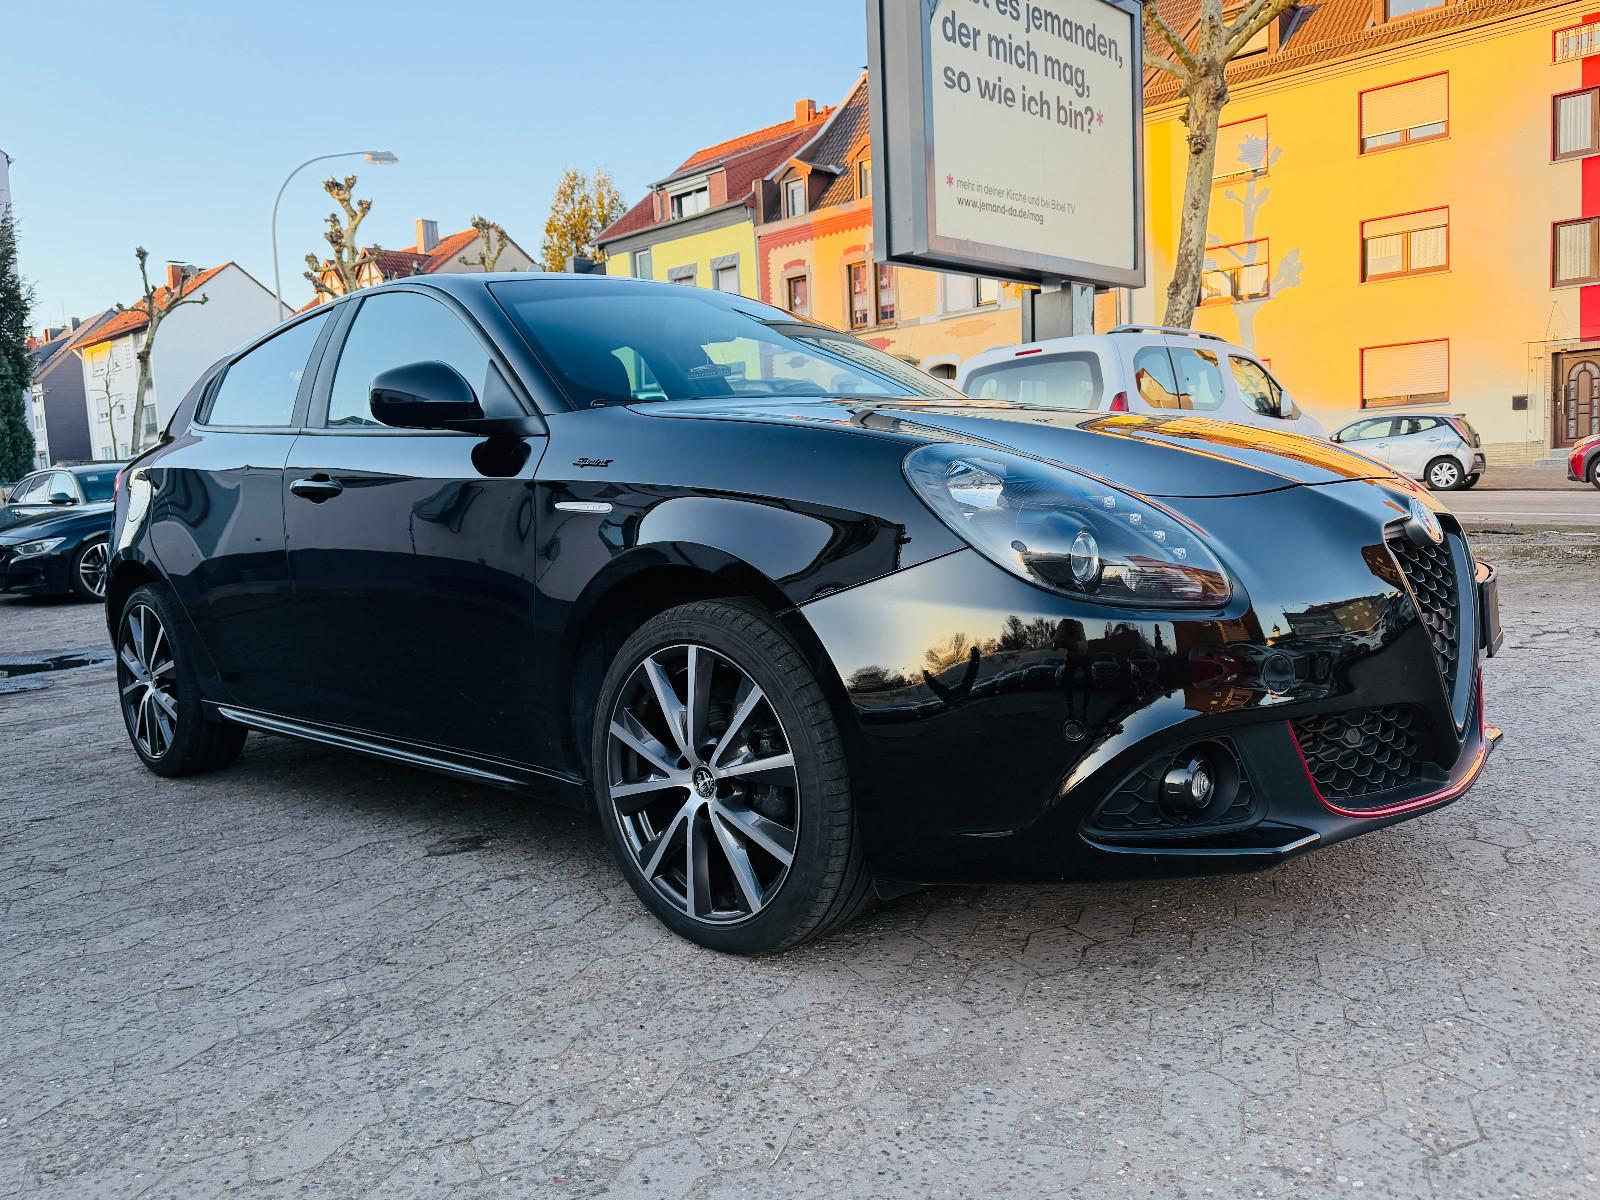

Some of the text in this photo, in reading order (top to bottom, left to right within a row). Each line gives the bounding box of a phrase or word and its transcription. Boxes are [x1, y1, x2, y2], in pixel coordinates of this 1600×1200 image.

[942, 10, 1090, 98] der mich mag,
[996, 0, 1123, 68] es jemanden,
[943, 65, 971, 93] so
[977, 76, 1016, 108] wie
[1021, 85, 1051, 120] ich
[956, 178, 1076, 214] mehr in deiner Kirche und bei Bibel TV
